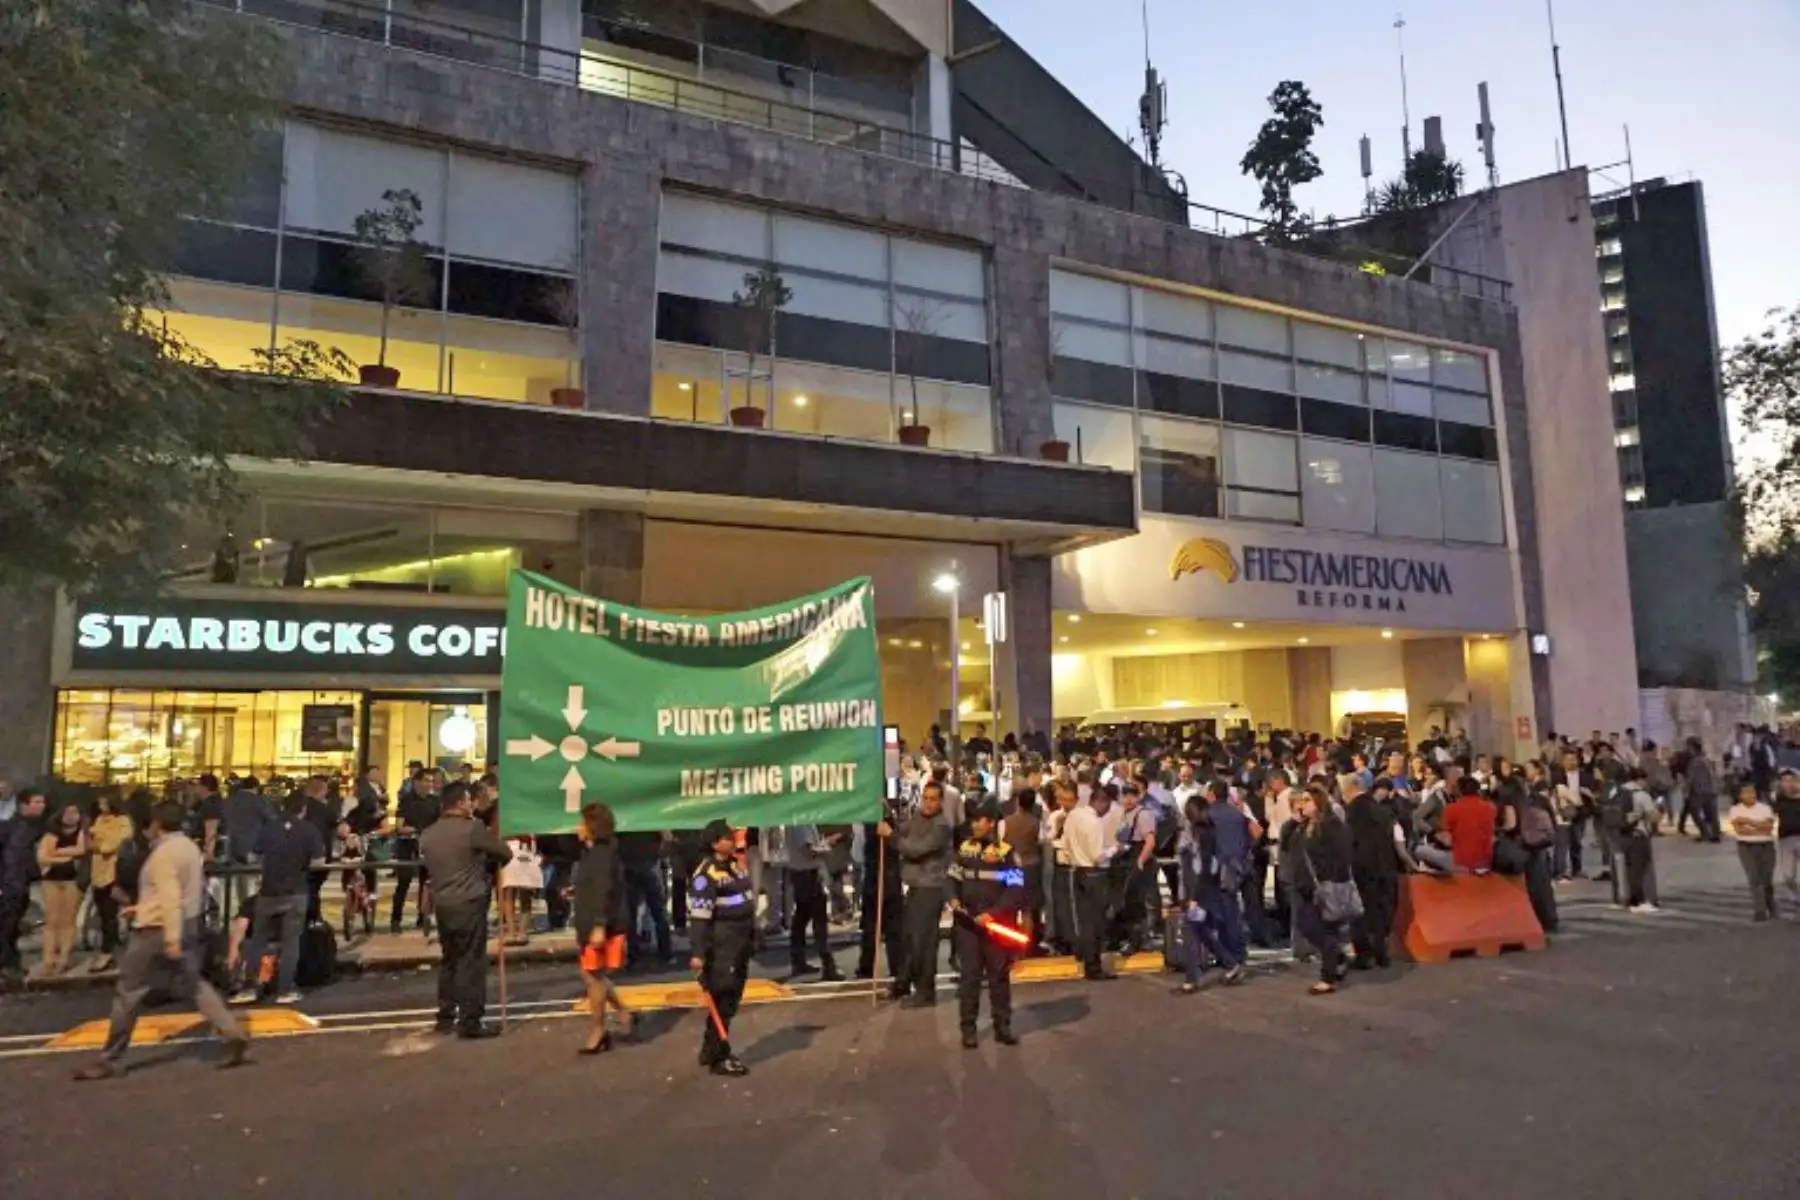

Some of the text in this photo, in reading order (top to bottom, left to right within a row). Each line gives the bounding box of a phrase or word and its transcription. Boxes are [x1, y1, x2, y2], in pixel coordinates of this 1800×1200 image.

[1243, 545, 1452, 594] FIESTAMERICANA
[526, 586, 868, 647] HOTEL FIESTA AMERICANA
[1297, 590, 1406, 612] REFORMA
[78, 613, 395, 656] STARBUCKS
[657, 699, 877, 737] PUNTO DE REUNION
[681, 763, 857, 797] MEETING POINT
